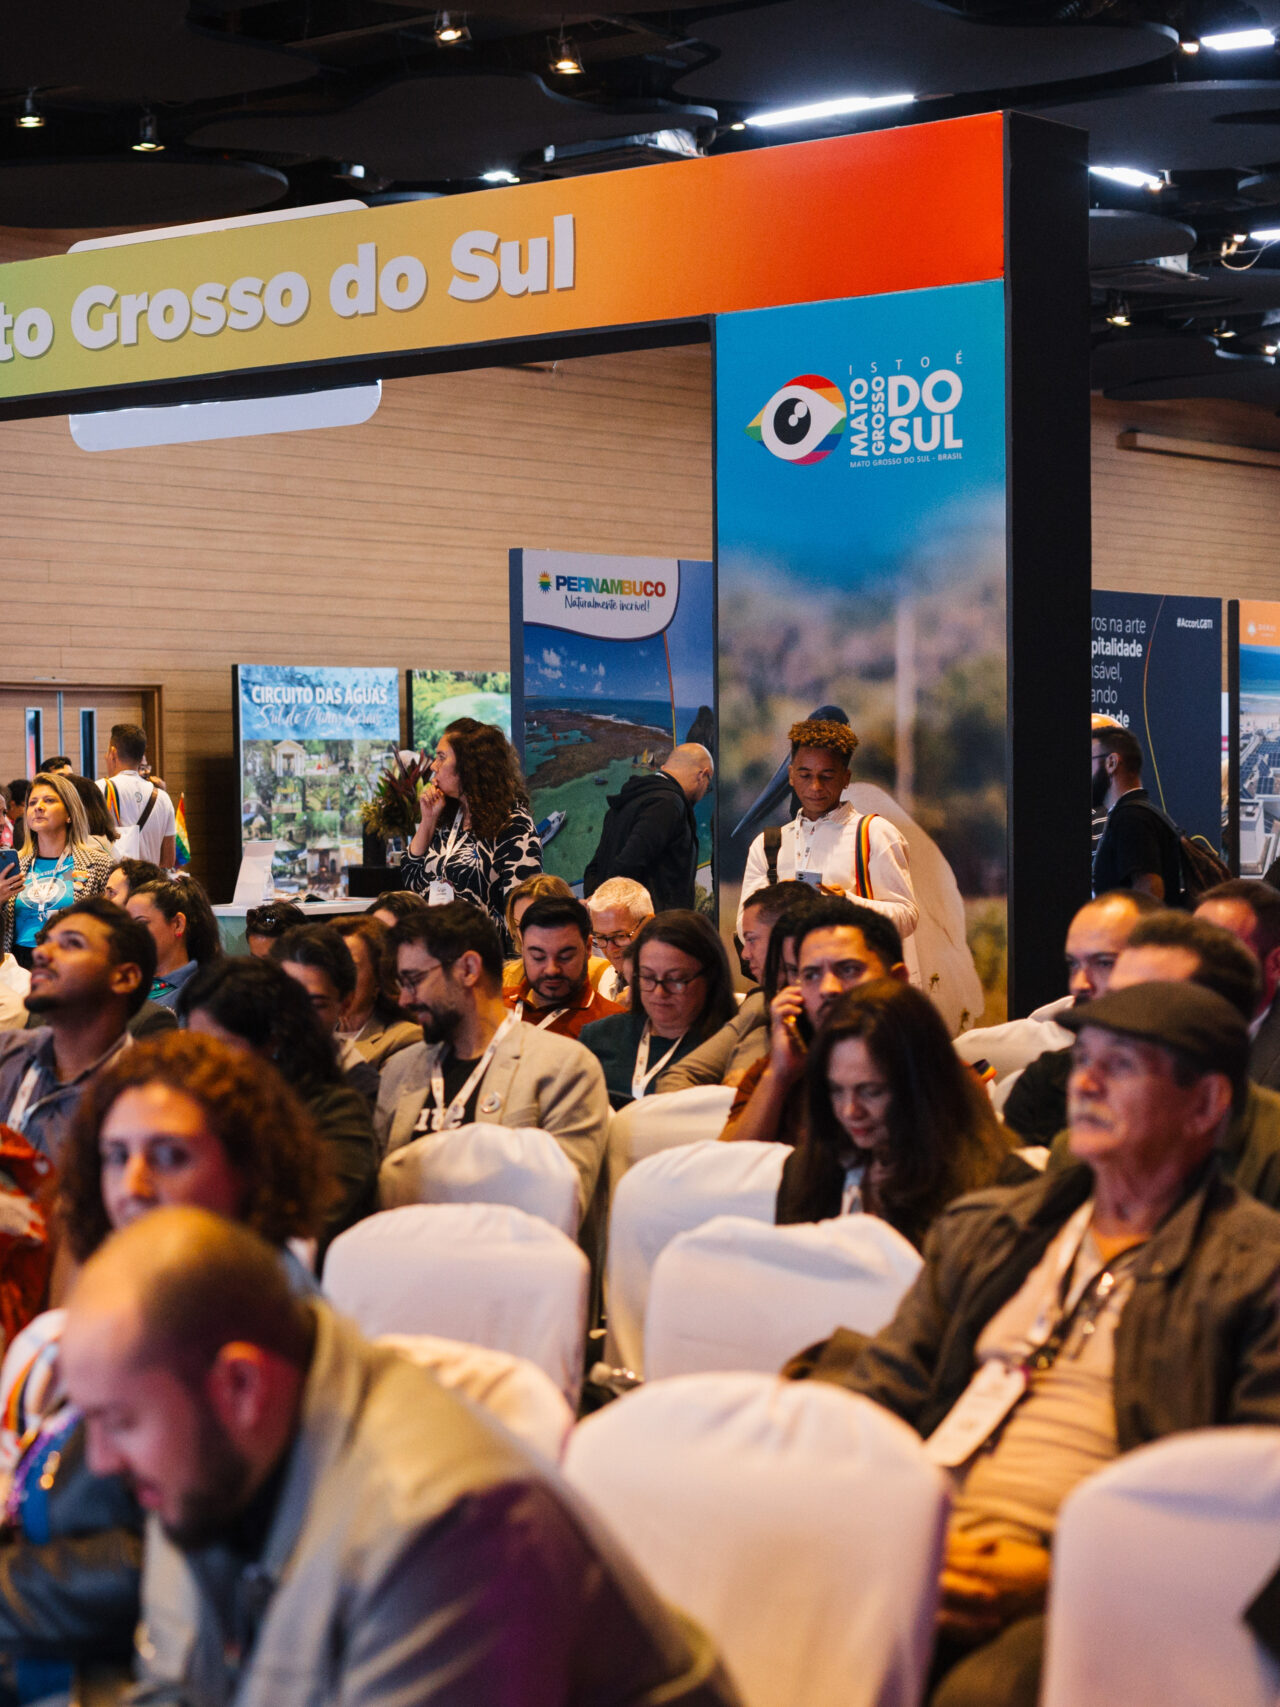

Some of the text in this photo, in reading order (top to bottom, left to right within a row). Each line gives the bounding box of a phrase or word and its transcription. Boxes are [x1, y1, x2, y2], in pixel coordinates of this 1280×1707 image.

[70, 268, 310, 351] Grosso
[329, 242, 428, 317] do
[447, 213, 577, 301] Sul
[887, 369, 963, 417] DO
[849, 378, 869, 457] MATO
[871, 376, 885, 456] GROSSO
[889, 413, 963, 454] SUL
[850, 460, 870, 468] MATO
[872, 458, 902, 467] GROSSO
[904, 456, 915, 464] DO
[917, 455, 930, 463] SUL
[938, 452, 963, 461] BRASIL
[556, 575, 666, 598] PERNAMBUCO
[564, 595, 617, 612] Naturalmente
[1109, 619, 1123, 633] na
[1125, 619, 1147, 634] arte
[251, 684, 388, 704] CIRCUITO DAS ÁGUAS
[257, 704, 285, 728] Sul
[286, 707, 301, 727] de
